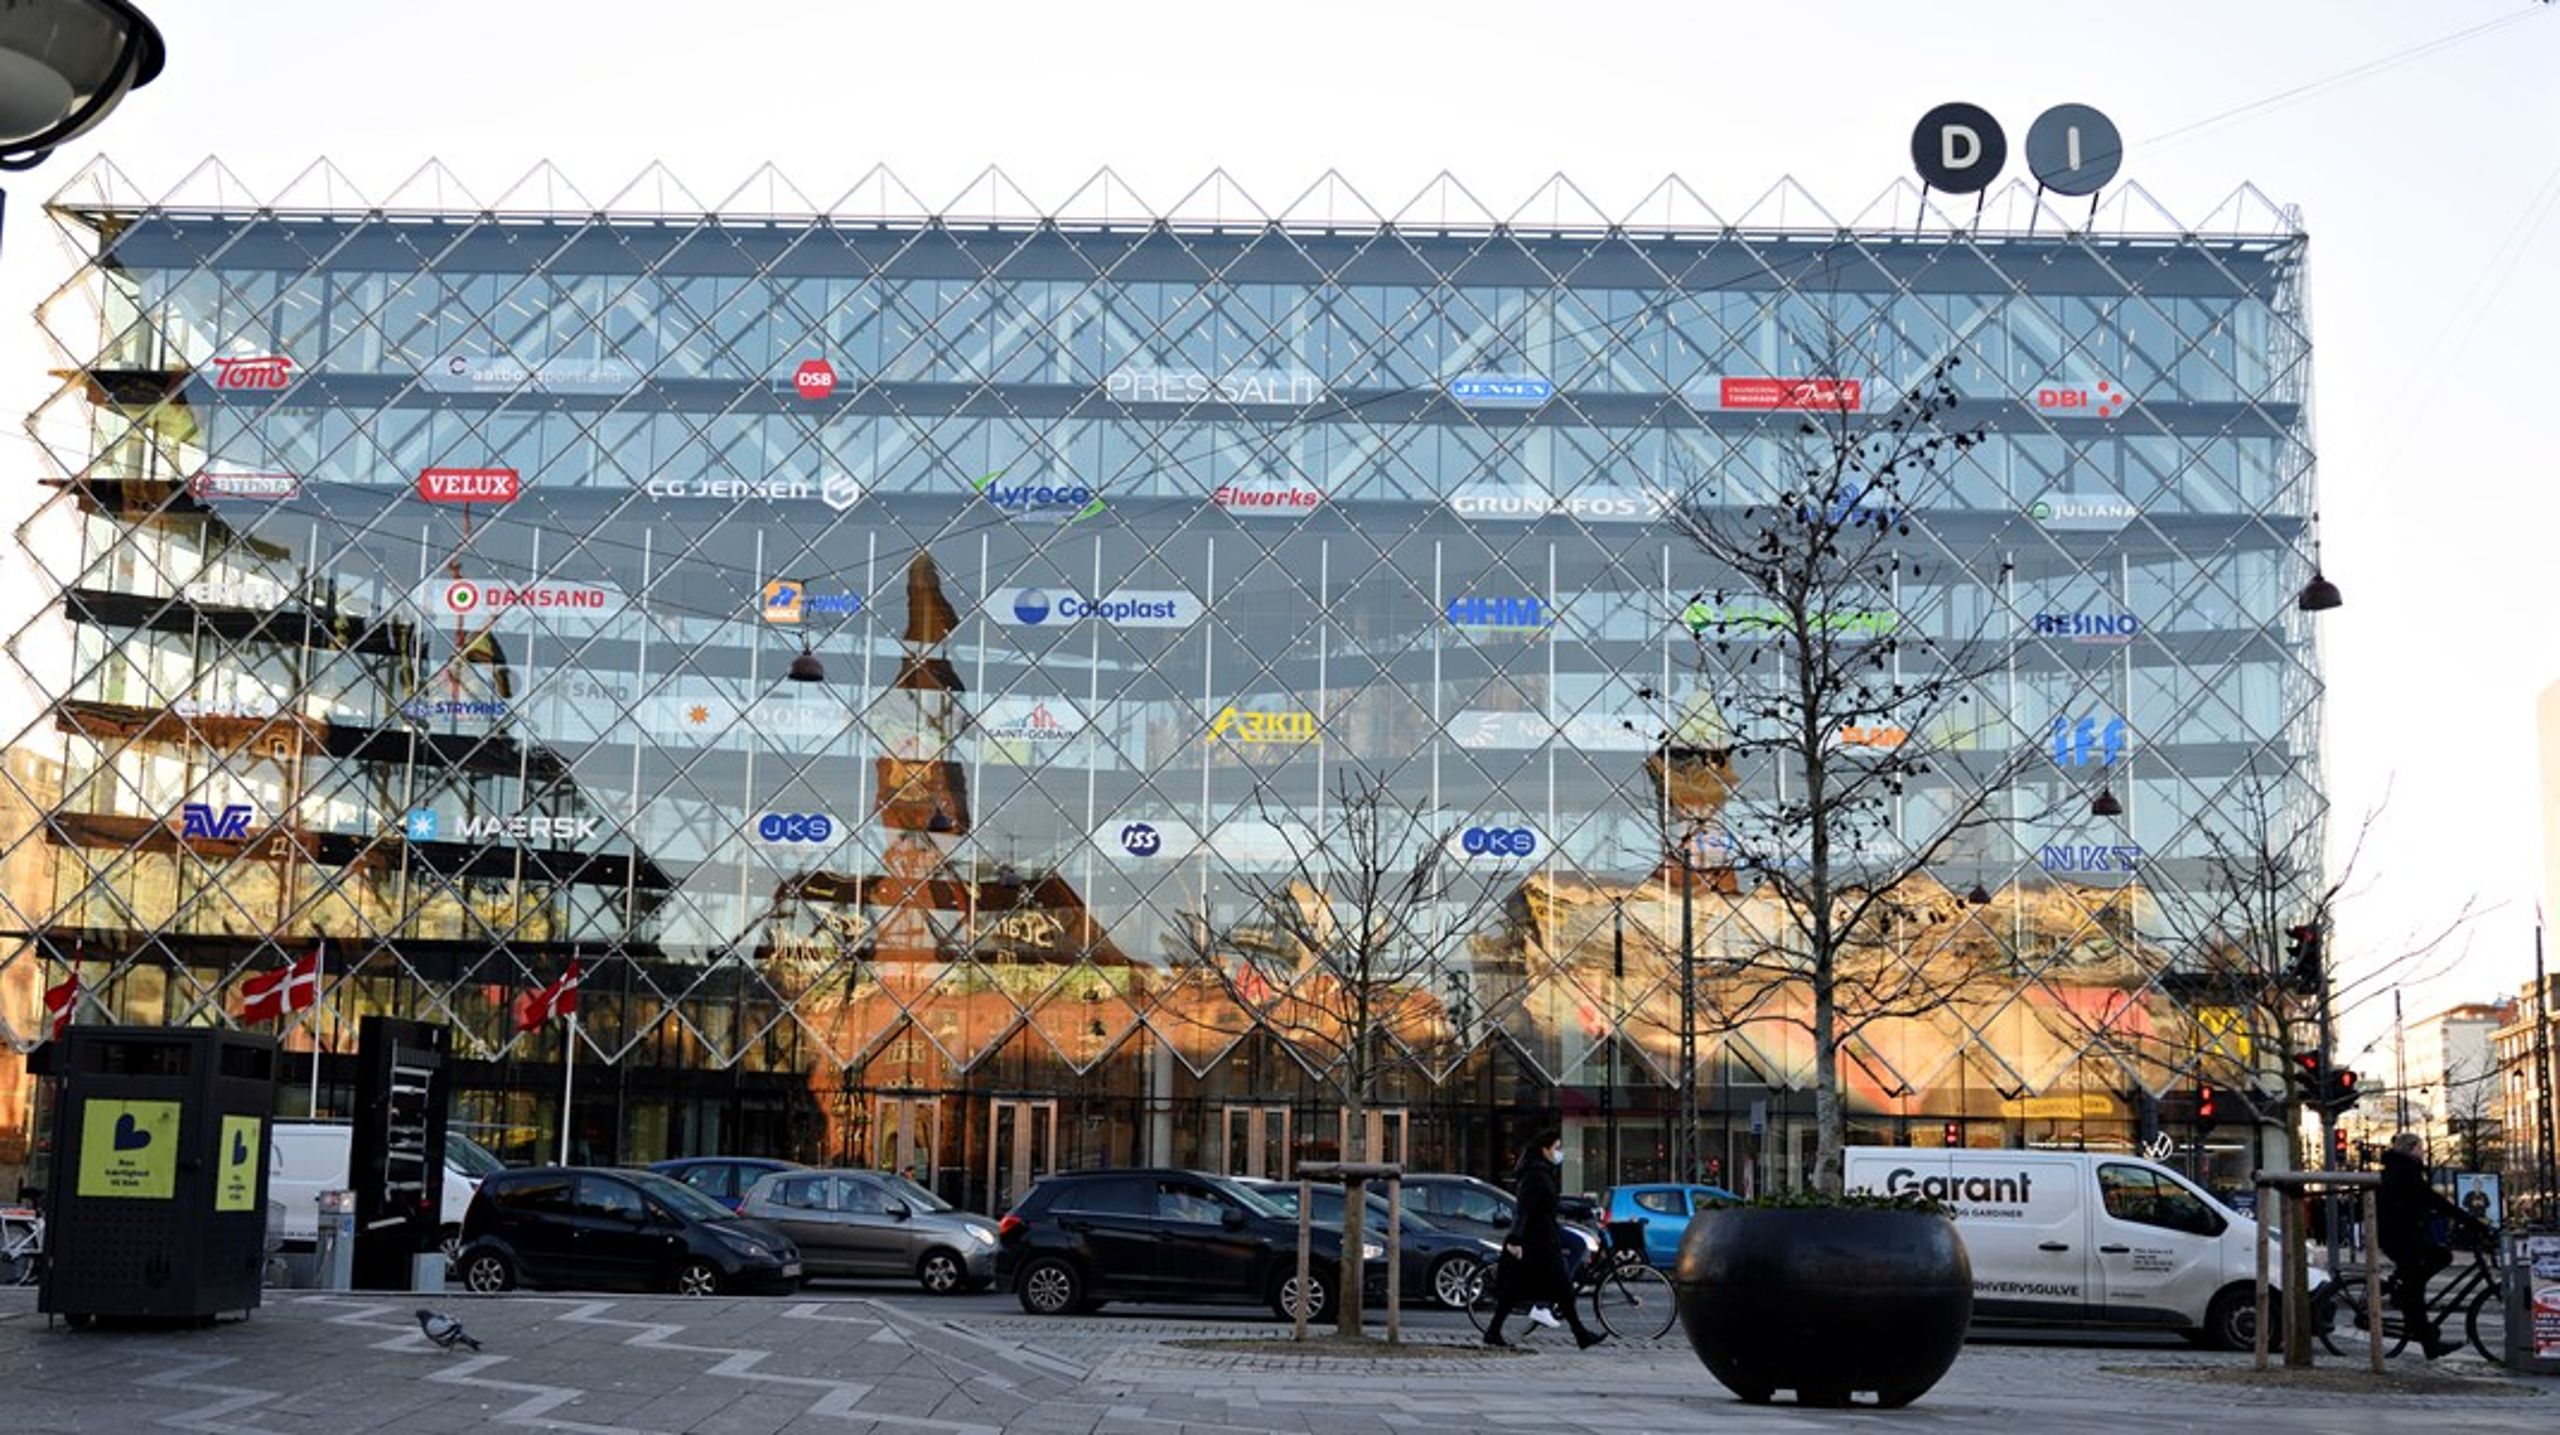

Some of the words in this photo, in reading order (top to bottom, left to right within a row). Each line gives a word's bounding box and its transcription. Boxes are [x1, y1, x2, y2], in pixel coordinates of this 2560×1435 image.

[1942, 124, 1981, 169] D
[2068, 126, 2080, 171] I
[213, 357, 292, 389] Toms
[798, 373, 832, 387] DSB
[1456, 382, 1547, 396] JENSEN
[2038, 390, 2088, 408] DBI
[427, 475, 510, 495] VELUX
[648, 480, 686, 497] CG
[693, 480, 807, 498] JENSEN
[988, 479, 1091, 509] Lyreco
[1217, 487, 1318, 508] Elworks
[2054, 504, 2137, 519] JULIANA
[486, 590, 605, 609] DANSAND
[1058, 597, 1176, 621] Coloplast
[2036, 614, 2138, 635] RESINO
[182, 804, 252, 839] AVK
[456, 817, 597, 839] MAERSK
[763, 817, 831, 839] JKS
[1466, 833, 1533, 851] JKS
[2042, 846, 2142, 873] NKT
[1887, 1168, 2031, 1203] Garant
